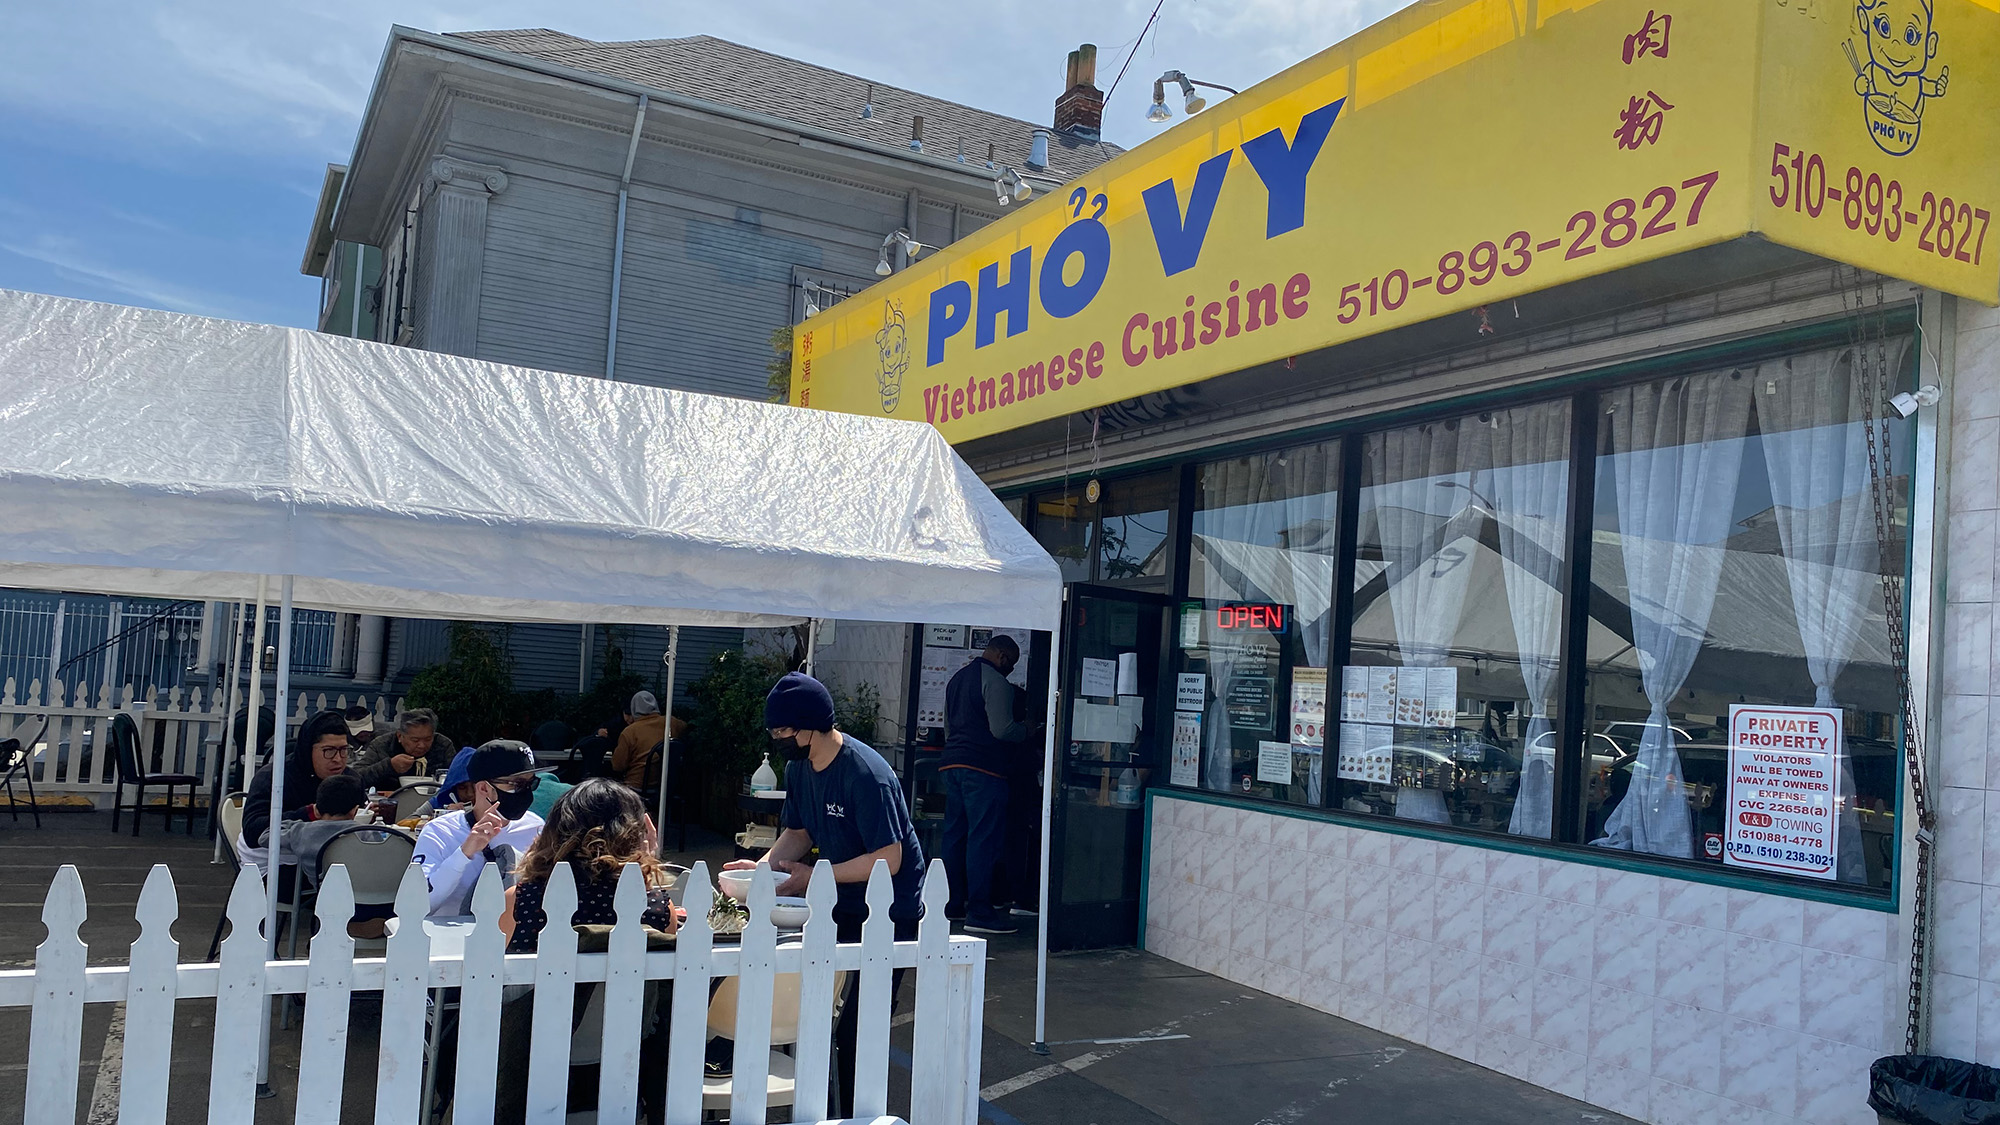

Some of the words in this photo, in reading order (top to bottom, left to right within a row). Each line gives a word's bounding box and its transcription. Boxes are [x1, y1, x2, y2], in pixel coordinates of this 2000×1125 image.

[1898, 129, 1912, 145] VY
[1141, 96, 1348, 277] VY
[1769, 142, 1991, 266] 510-893-2827
[1336, 170, 1719, 324] 510-893-2827
[923, 341, 1105, 425] Vietnamese
[1121, 273, 1311, 368] Cuisine
[1217, 606, 1282, 628] OPEN
[1178, 697, 1203, 705] RESTROOM
[1748, 718, 1819, 733] PRIVATE
[1739, 733, 1829, 750] PROPERTY
[1753, 753, 1812, 765] VIOLATORS
[1742, 765, 1766, 774] WILL
[1769, 767, 1782, 775] BE
[1785, 768, 1823, 778] TOWED
[1736, 776, 1764, 786] AWAY
[1766, 778, 1780, 787] AT
[1783, 780, 1829, 791] OWNERS
[1758, 790, 1807, 801] EXPENSE
[1738, 800, 1765, 810] CVC
[1769, 802, 1828, 817] 22658(a)
[1774, 817, 1823, 833] TOWING
[1737, 829, 1823, 848] (510)881-4778
[1726, 841, 1754, 855] O.P.D.
[1756, 846, 1783, 859] (510)
[1785, 850, 1834, 866] 238-3021
